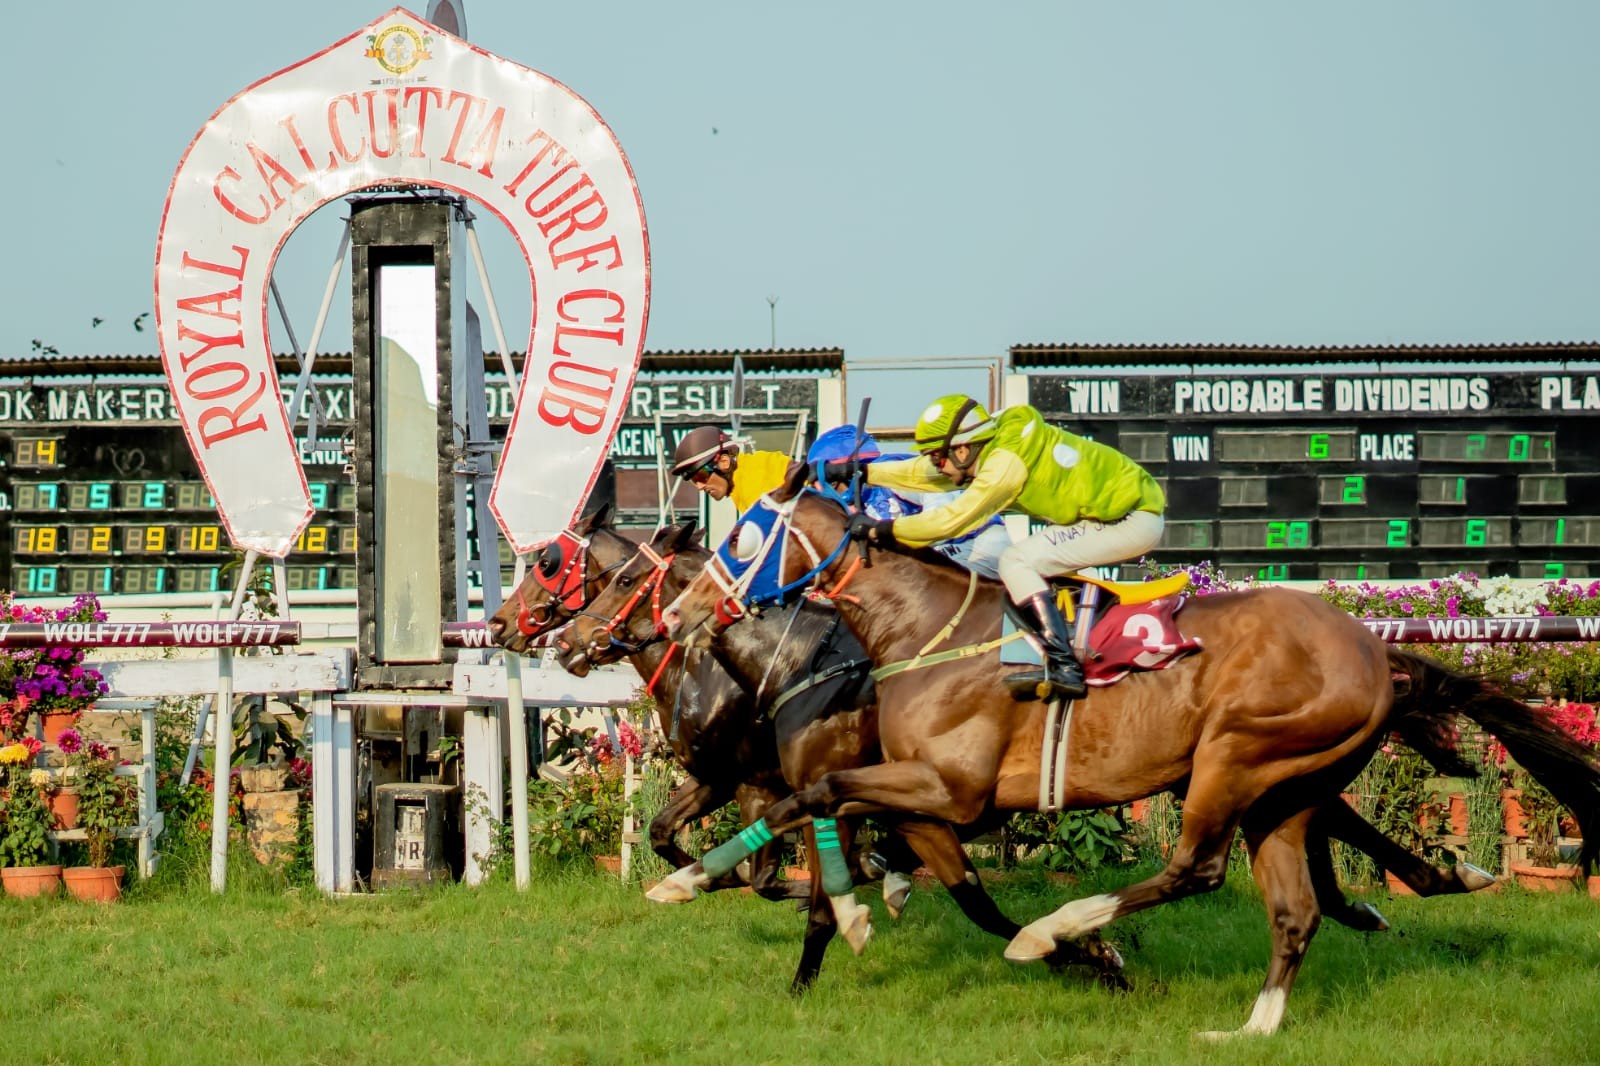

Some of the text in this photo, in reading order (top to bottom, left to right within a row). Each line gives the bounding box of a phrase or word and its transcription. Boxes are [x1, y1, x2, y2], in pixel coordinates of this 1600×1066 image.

[177, 87, 625, 450] ROYAL CALCUTTA TURF CLUB
[1069, 380, 1120, 413] WIN
[1175, 378, 1324, 412] PROBABLE
[1335, 378, 1490, 411] DIVIDENDS
[36, 440, 56, 464] 4
[1172, 436, 1210, 461] WIN
[1309, 433, 1329, 459] 6
[1360, 434, 1415, 460] PLACE
[37, 483, 58, 510] 7
[89, 483, 111, 509] 5
[144, 483, 165, 508] 2
[1342, 476, 1364, 503] 2
[28, 527, 57, 553] 18
[91, 527, 112, 551] 2
[145, 526, 165, 551] 9
[190, 526, 219, 551] 10
[1387, 520, 1409, 547] 2
[1465, 519, 1487, 546] 6
[27, 567, 57, 592] 10
[44, 622, 280, 644] WOLF777 WOLF777
[1122, 613, 1177, 667] 3
[1428, 618, 1540, 639] WOLF777
